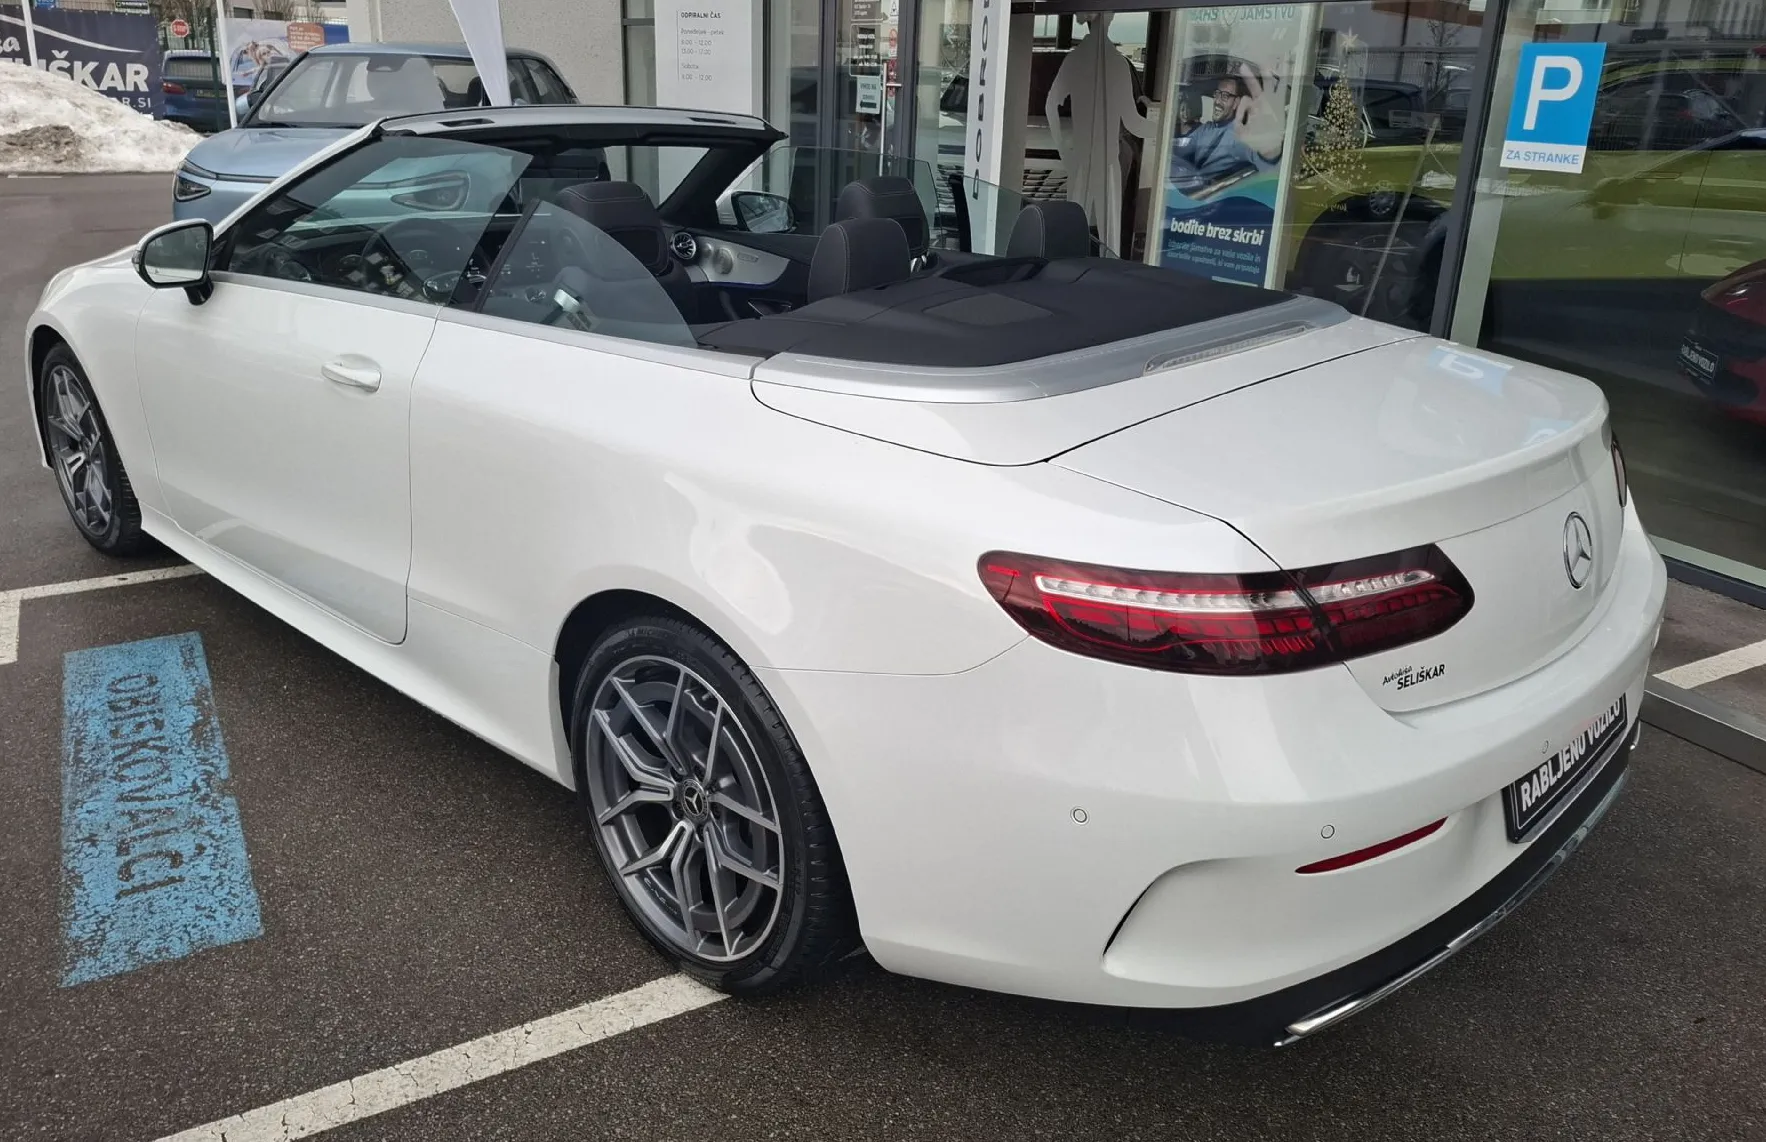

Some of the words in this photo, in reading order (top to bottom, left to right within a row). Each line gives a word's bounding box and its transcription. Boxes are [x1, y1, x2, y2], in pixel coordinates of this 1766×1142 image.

[710, 10, 721, 18] ČAS
[1523, 55, 1583, 130] P
[1506, 149, 1521, 161] ZA
[1523, 151, 1580, 165] STRANKE
[1170, 217, 1205, 236] bodite
[1205, 222, 1233, 241] brez
[1232, 226, 1265, 246] skrbi
[1397, 664, 1445, 690] SELIŠKAR
[1520, 730, 1586, 812] RABLJENO
[1587, 697, 1620, 746] VOZILO
[107, 672, 186, 901] OBISKOVALCI
